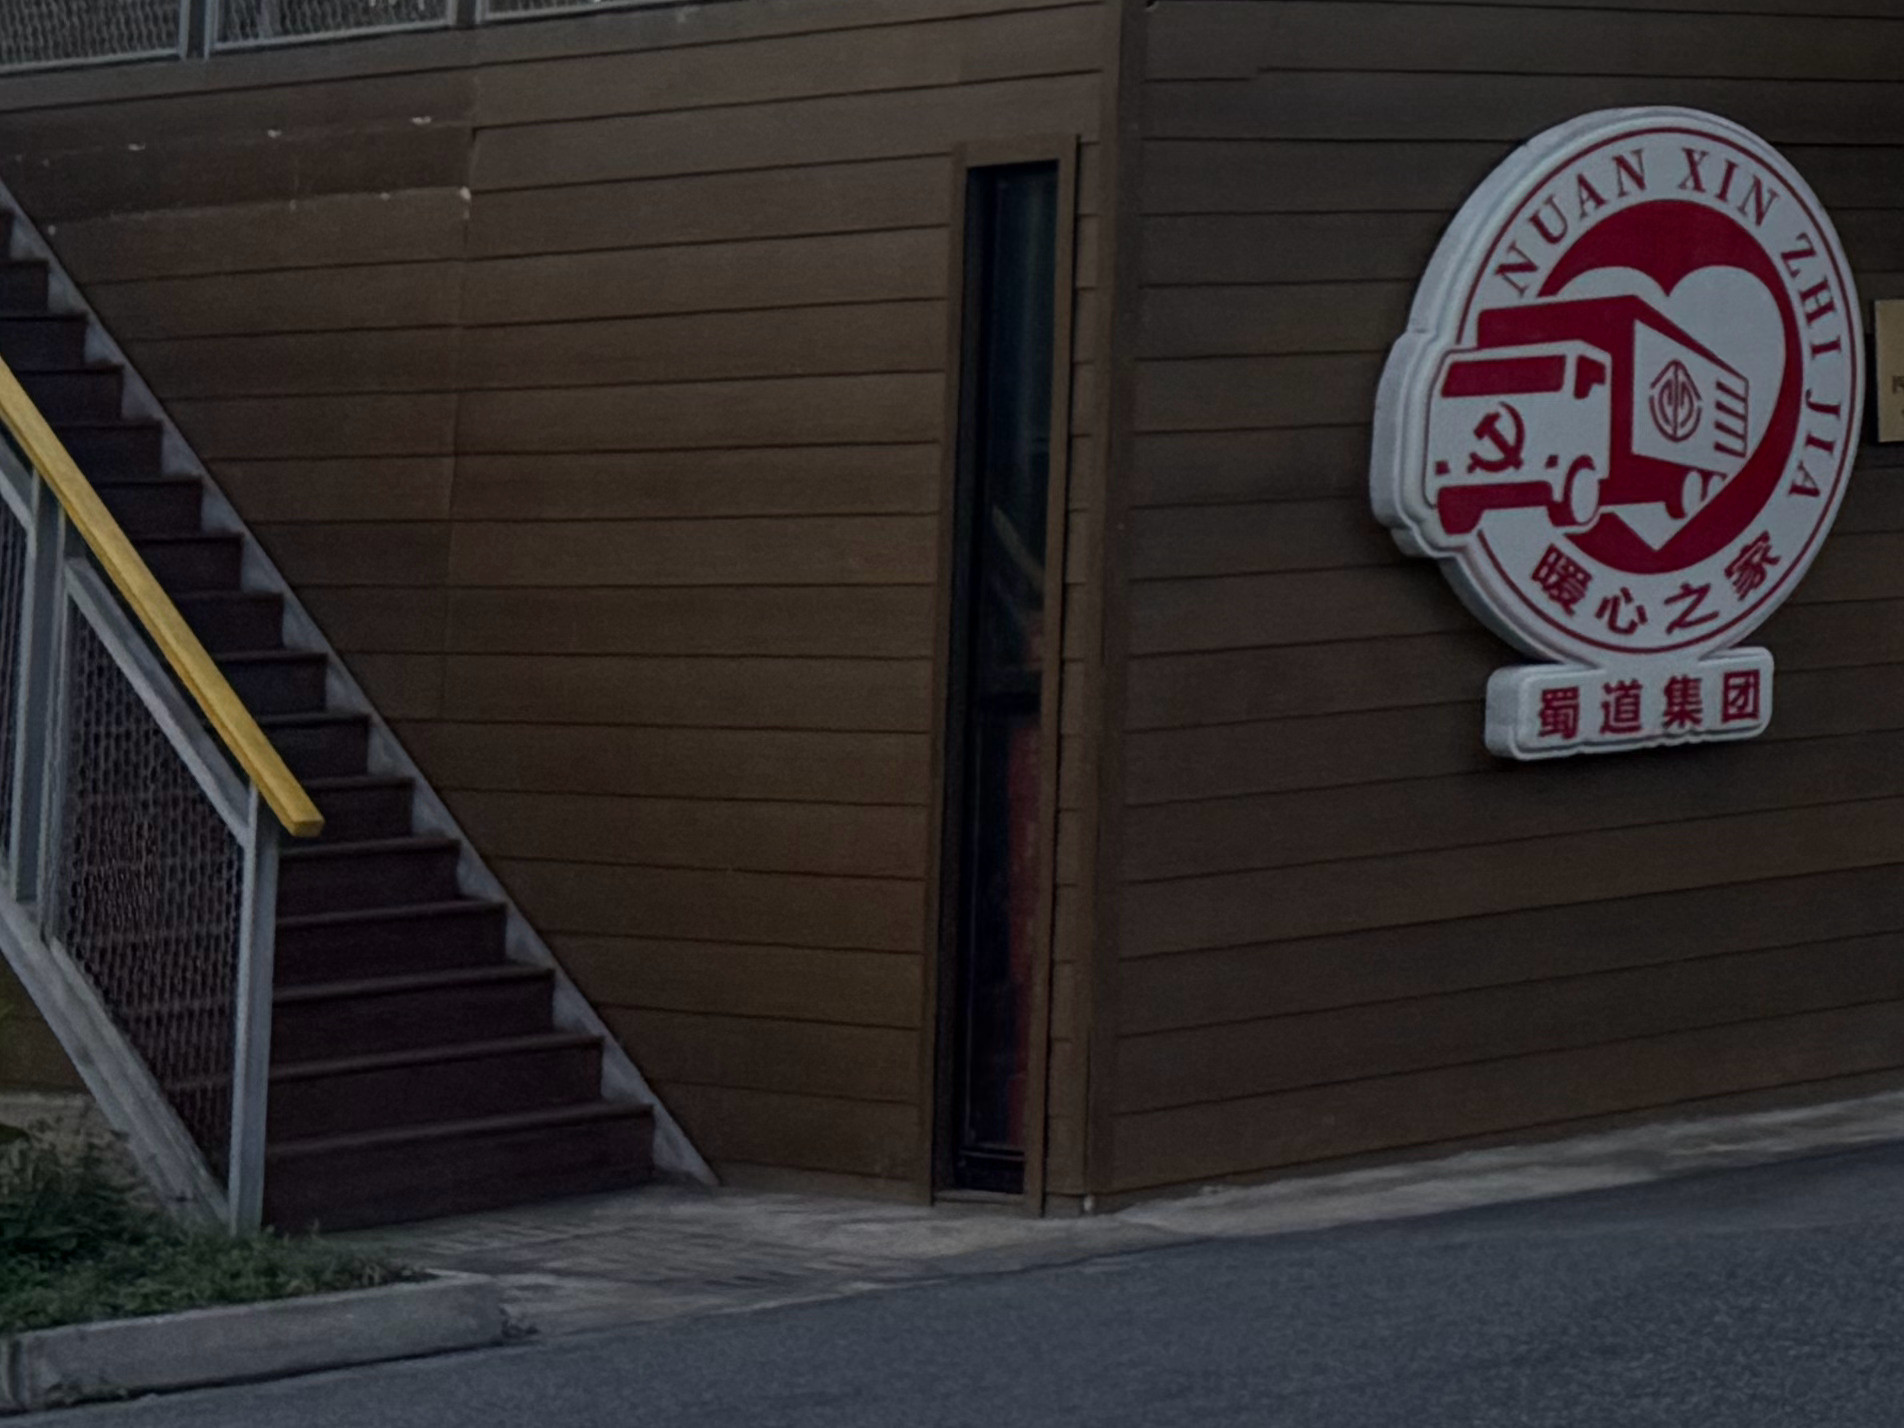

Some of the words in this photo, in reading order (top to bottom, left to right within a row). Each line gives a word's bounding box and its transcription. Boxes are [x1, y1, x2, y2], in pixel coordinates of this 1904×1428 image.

[1495, 148, 1648, 296] NUAN
[1678, 148, 1780, 225] XIN
[1779, 232, 1842, 358] ZHI
[1785, 387, 1841, 503] JIA
[1530, 529, 1785, 636] 暖心之家
[1538, 668, 1764, 741] 蜀道集团
